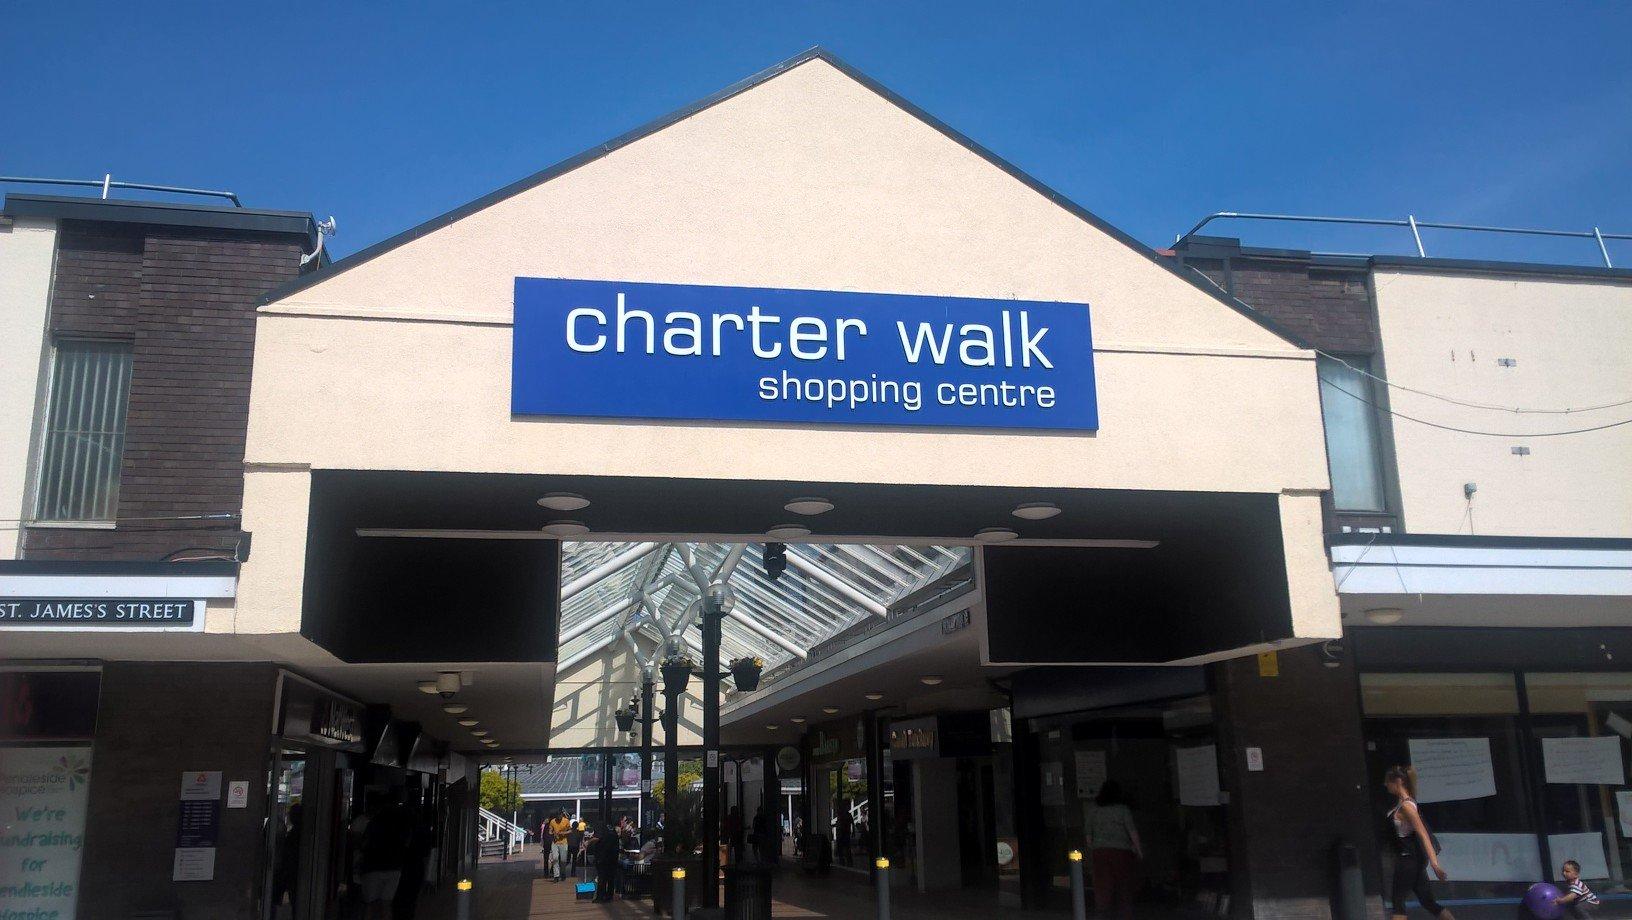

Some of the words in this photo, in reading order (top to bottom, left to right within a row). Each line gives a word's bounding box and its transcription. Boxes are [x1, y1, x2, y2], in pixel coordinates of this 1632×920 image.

[566, 292, 868, 361] charter
[896, 311, 1055, 369] walk
[759, 370, 922, 411] shopping
[937, 381, 1056, 408] centre
[30, 603, 107, 619] JAMES'S
[116, 603, 187, 619] STREET
[16, 806, 66, 822] We're
[0, 830, 80, 850] undraising
[21, 857, 47, 872] for
[0, 880, 73, 898] endleside
